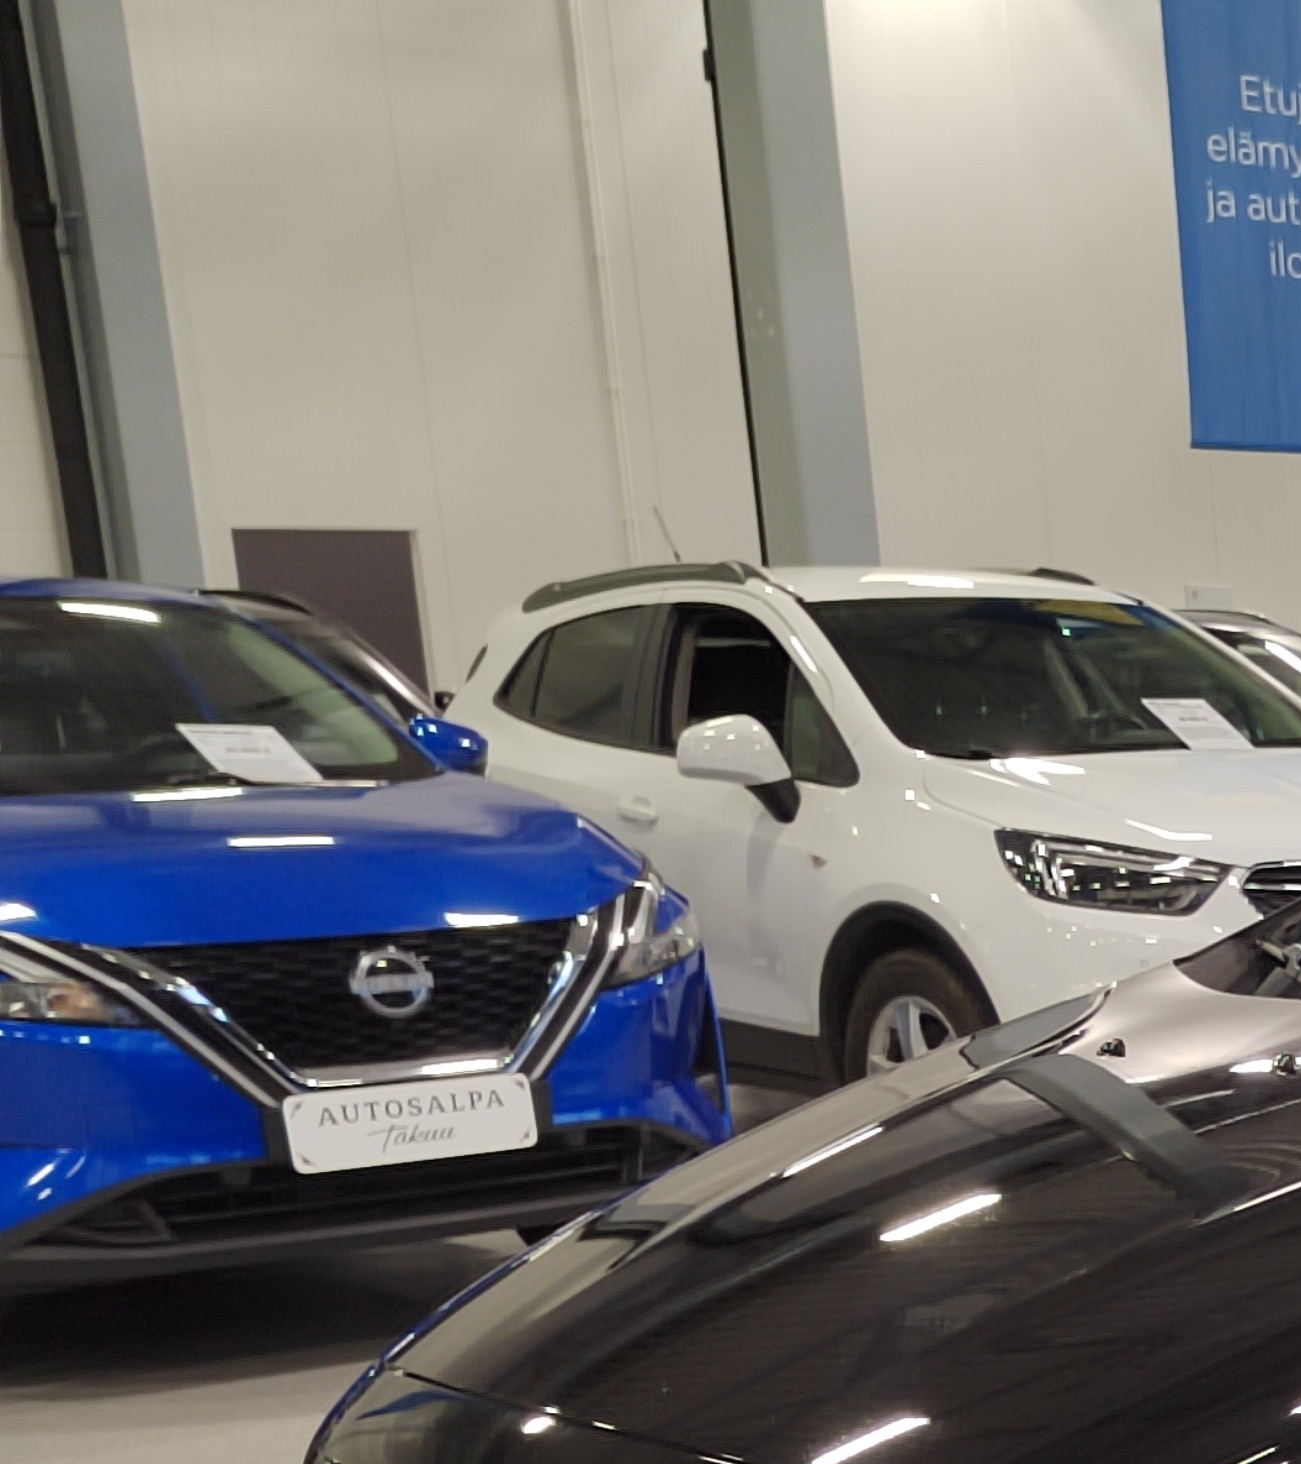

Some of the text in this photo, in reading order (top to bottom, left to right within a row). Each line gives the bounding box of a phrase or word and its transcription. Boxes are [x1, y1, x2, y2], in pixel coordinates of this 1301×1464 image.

[1206, 180, 1236, 224] ja
[317, 1089, 506, 1128] AUTOSALPA
[366, 1123, 456, 1154] Takuu
